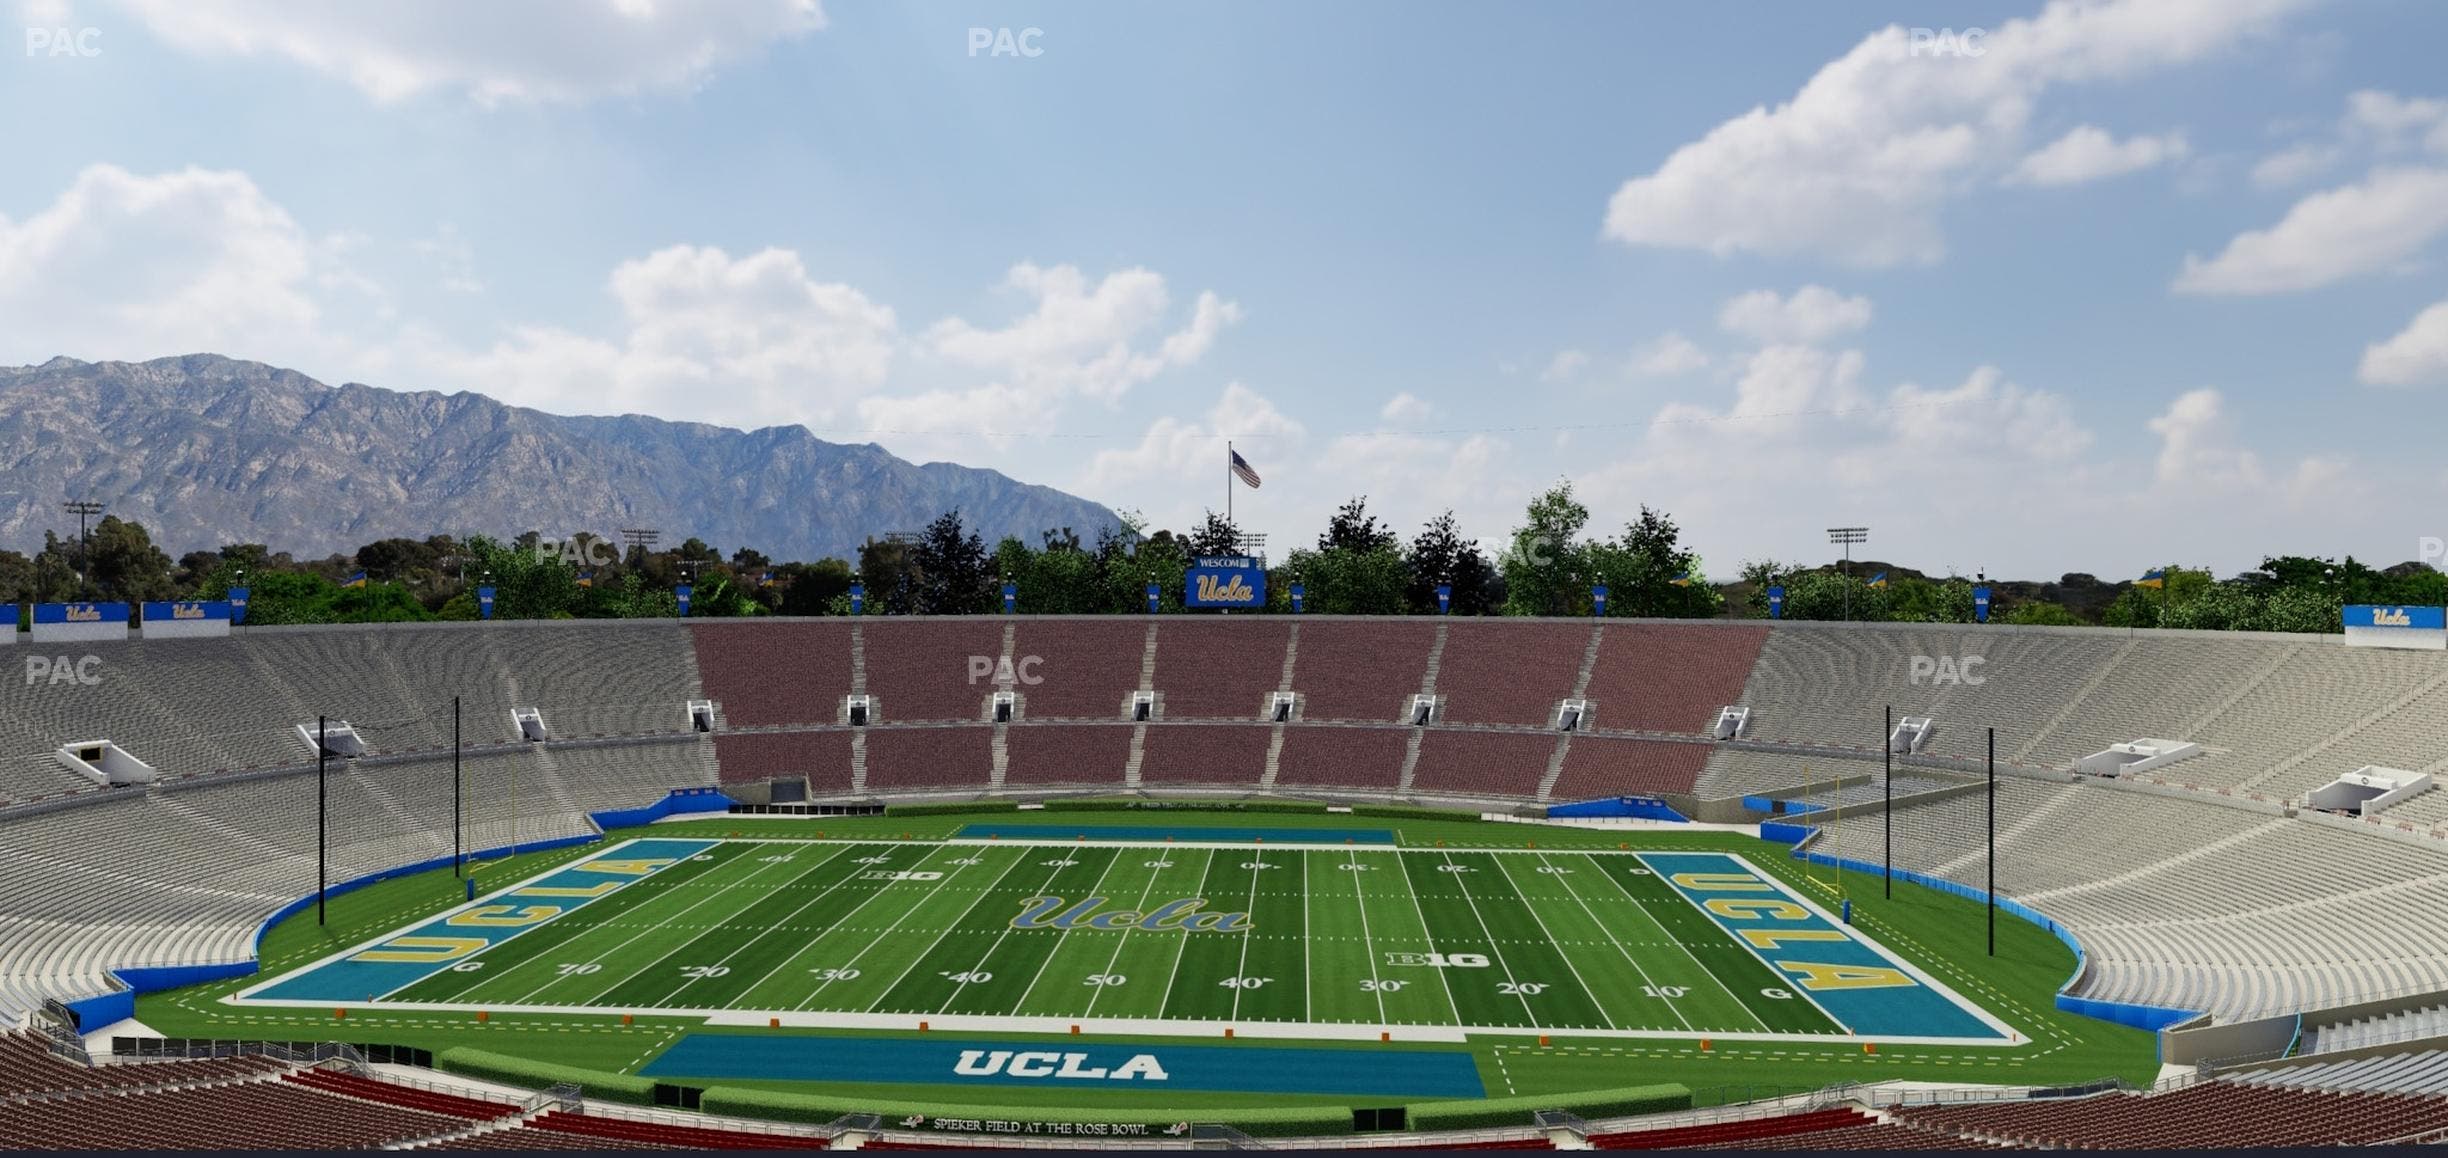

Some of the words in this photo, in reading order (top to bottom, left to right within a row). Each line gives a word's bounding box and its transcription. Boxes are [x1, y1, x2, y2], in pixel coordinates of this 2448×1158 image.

[1200, 558, 1239, 568] WESCOM
[1196, 574, 1254, 602] Ucla
[346, 858, 680, 963] UCLA
[1008, 895, 1256, 933] Ucla
[1668, 872, 1921, 992] UCLA
[684, 964, 731, 978] 20
[815, 968, 861, 981] 30
[945, 970, 993, 983] 40
[1082, 973, 1127, 987] 50
[1218, 976, 1263, 989] 40
[1358, 978, 1403, 992] 30
[1495, 982, 1542, 995] 20
[1639, 984, 1684, 998] 10
[1760, 987, 1793, 1000] G
[952, 1049, 1169, 1081] UCLA
[933, 1118, 982, 1132] SPIEKER
[985, 1120, 1021, 1133] FIELD
[1024, 1122, 1042, 1133] AT
[1046, 1122, 1072, 1134] THE
[1075, 1122, 1108, 1136] ROSE
[1111, 1123, 1149, 1136] BOWL
